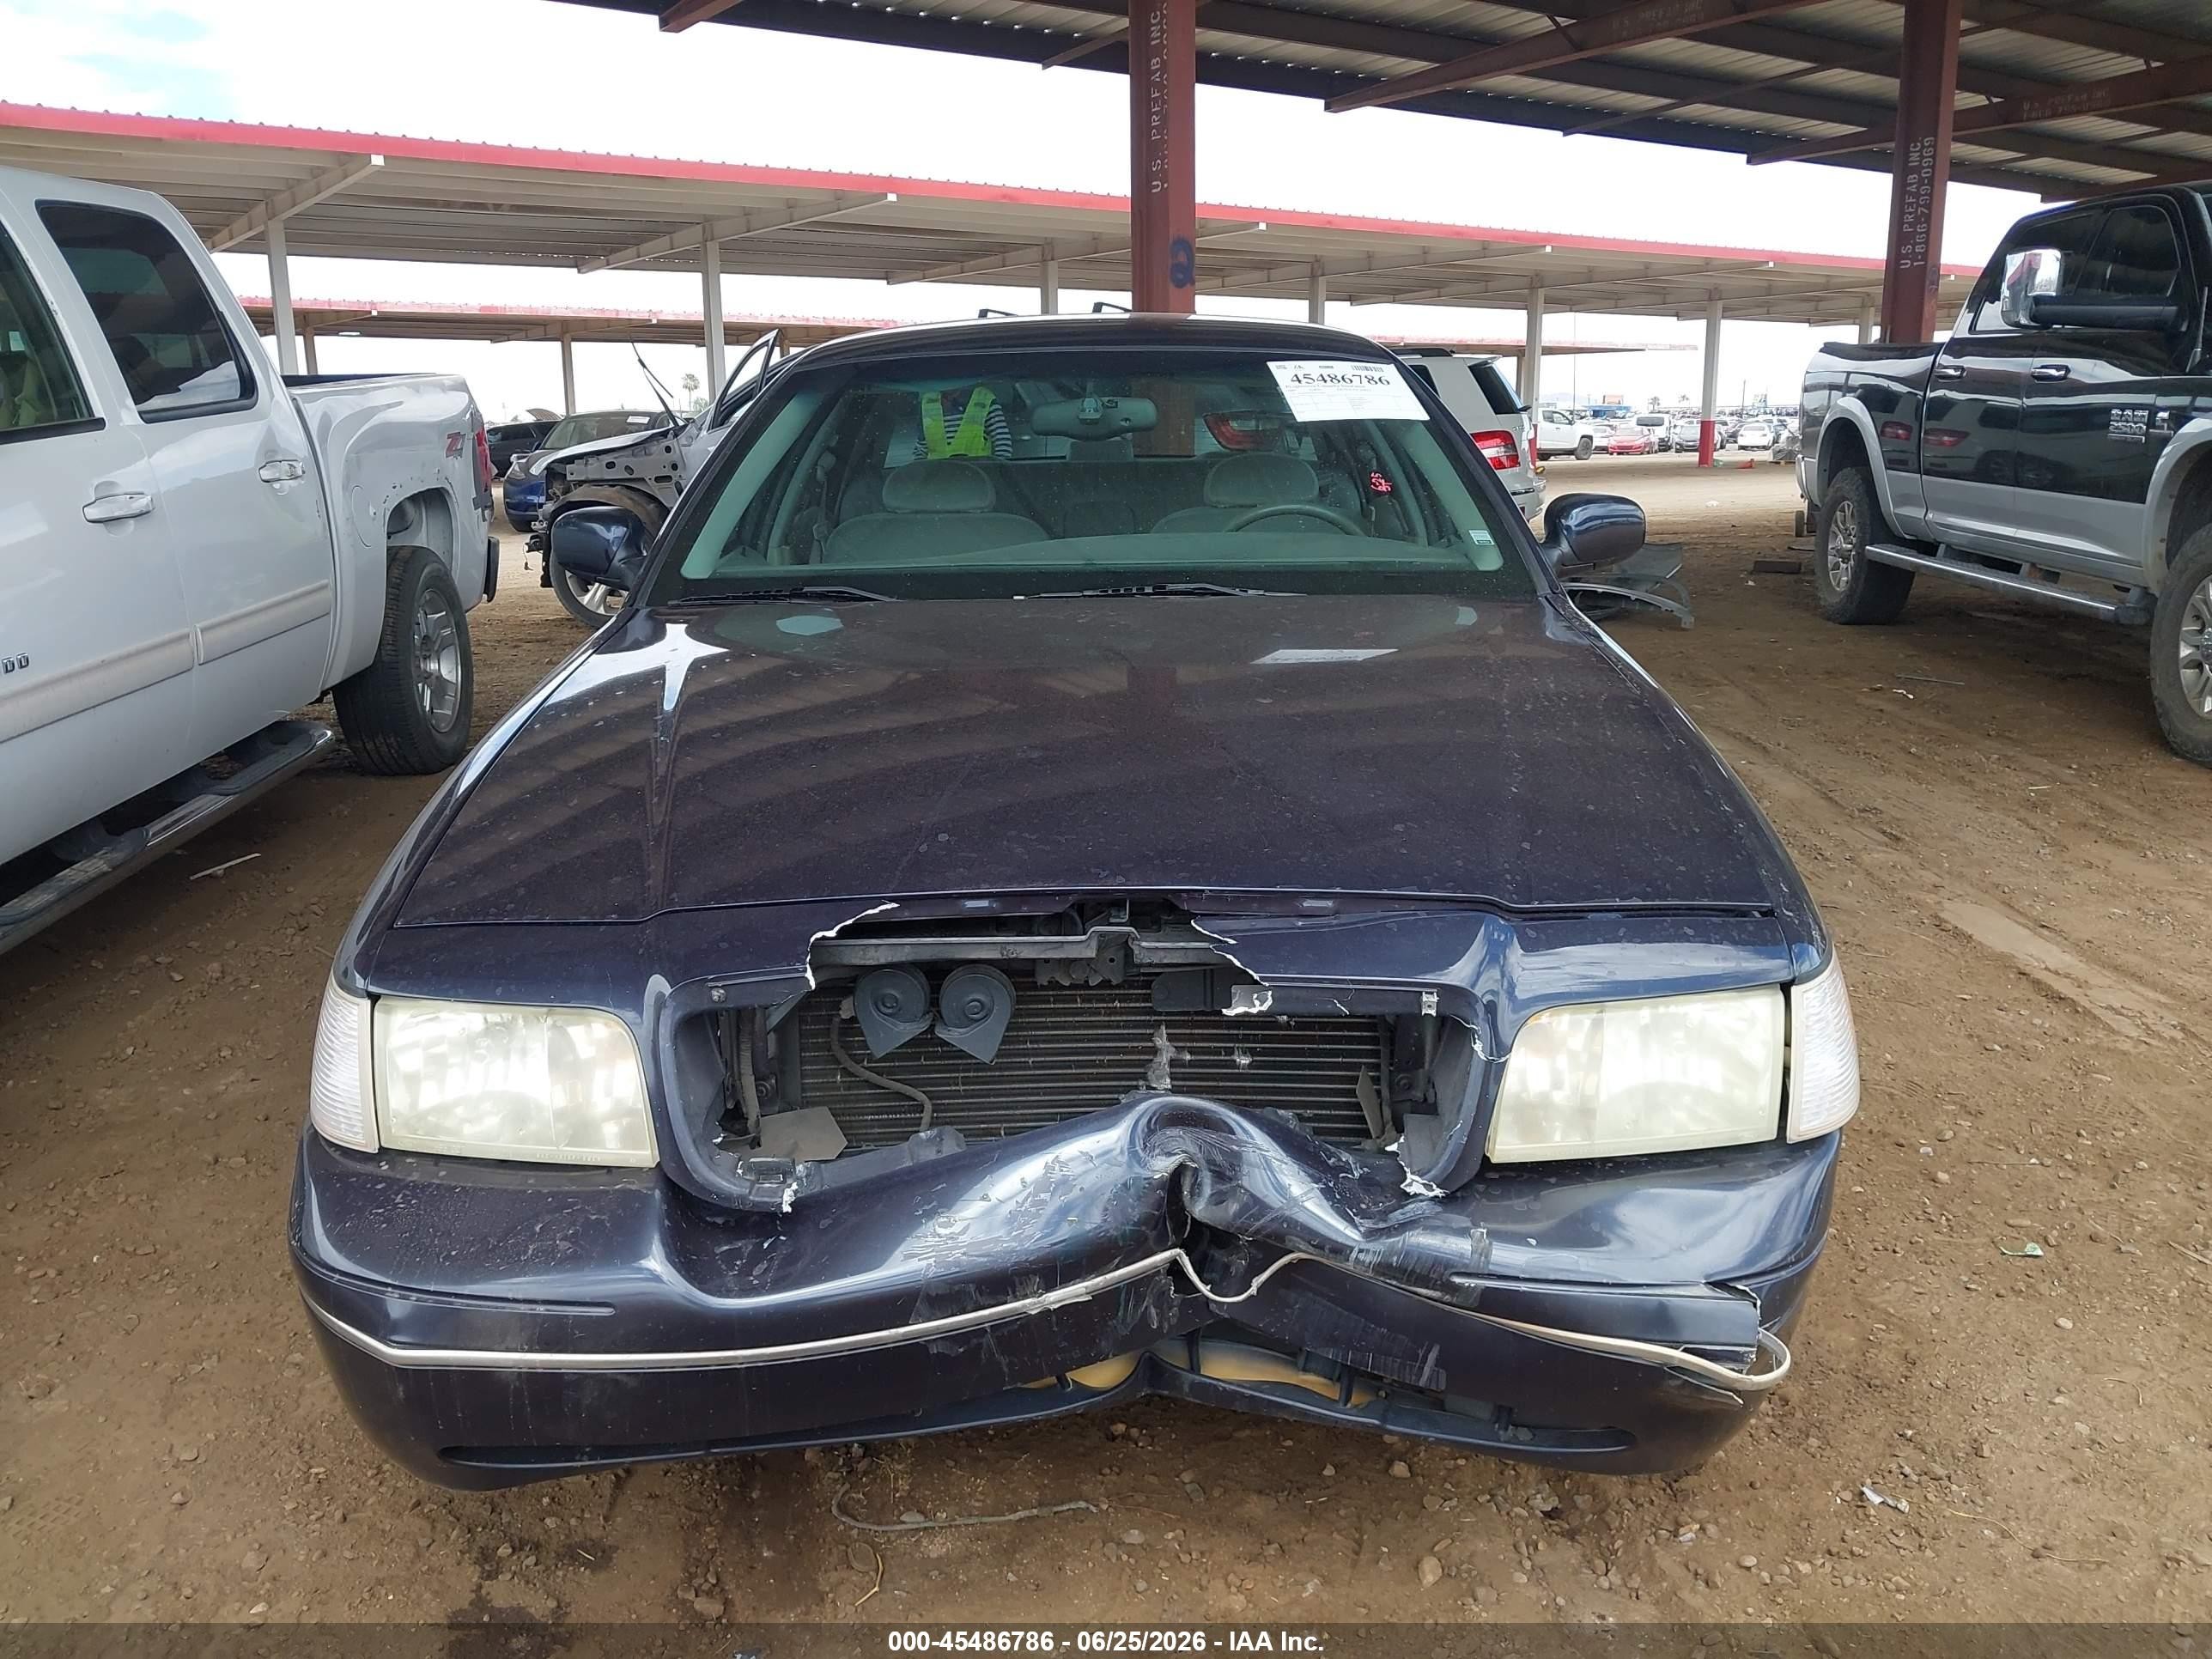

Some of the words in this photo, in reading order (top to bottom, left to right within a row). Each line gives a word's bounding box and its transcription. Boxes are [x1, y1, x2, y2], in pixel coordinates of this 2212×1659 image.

[1151, 57, 1161, 141] PREFAB
[1151, 151, 1162, 193] U.S.
[1908, 137, 1923, 167] INC.
[1903, 173, 1918, 232] PREFAB
[1913, 137, 1936, 267] 1-866-799-0969
[1899, 240, 1915, 269] U.S.
[1291, 373, 1390, 385] 45486786
